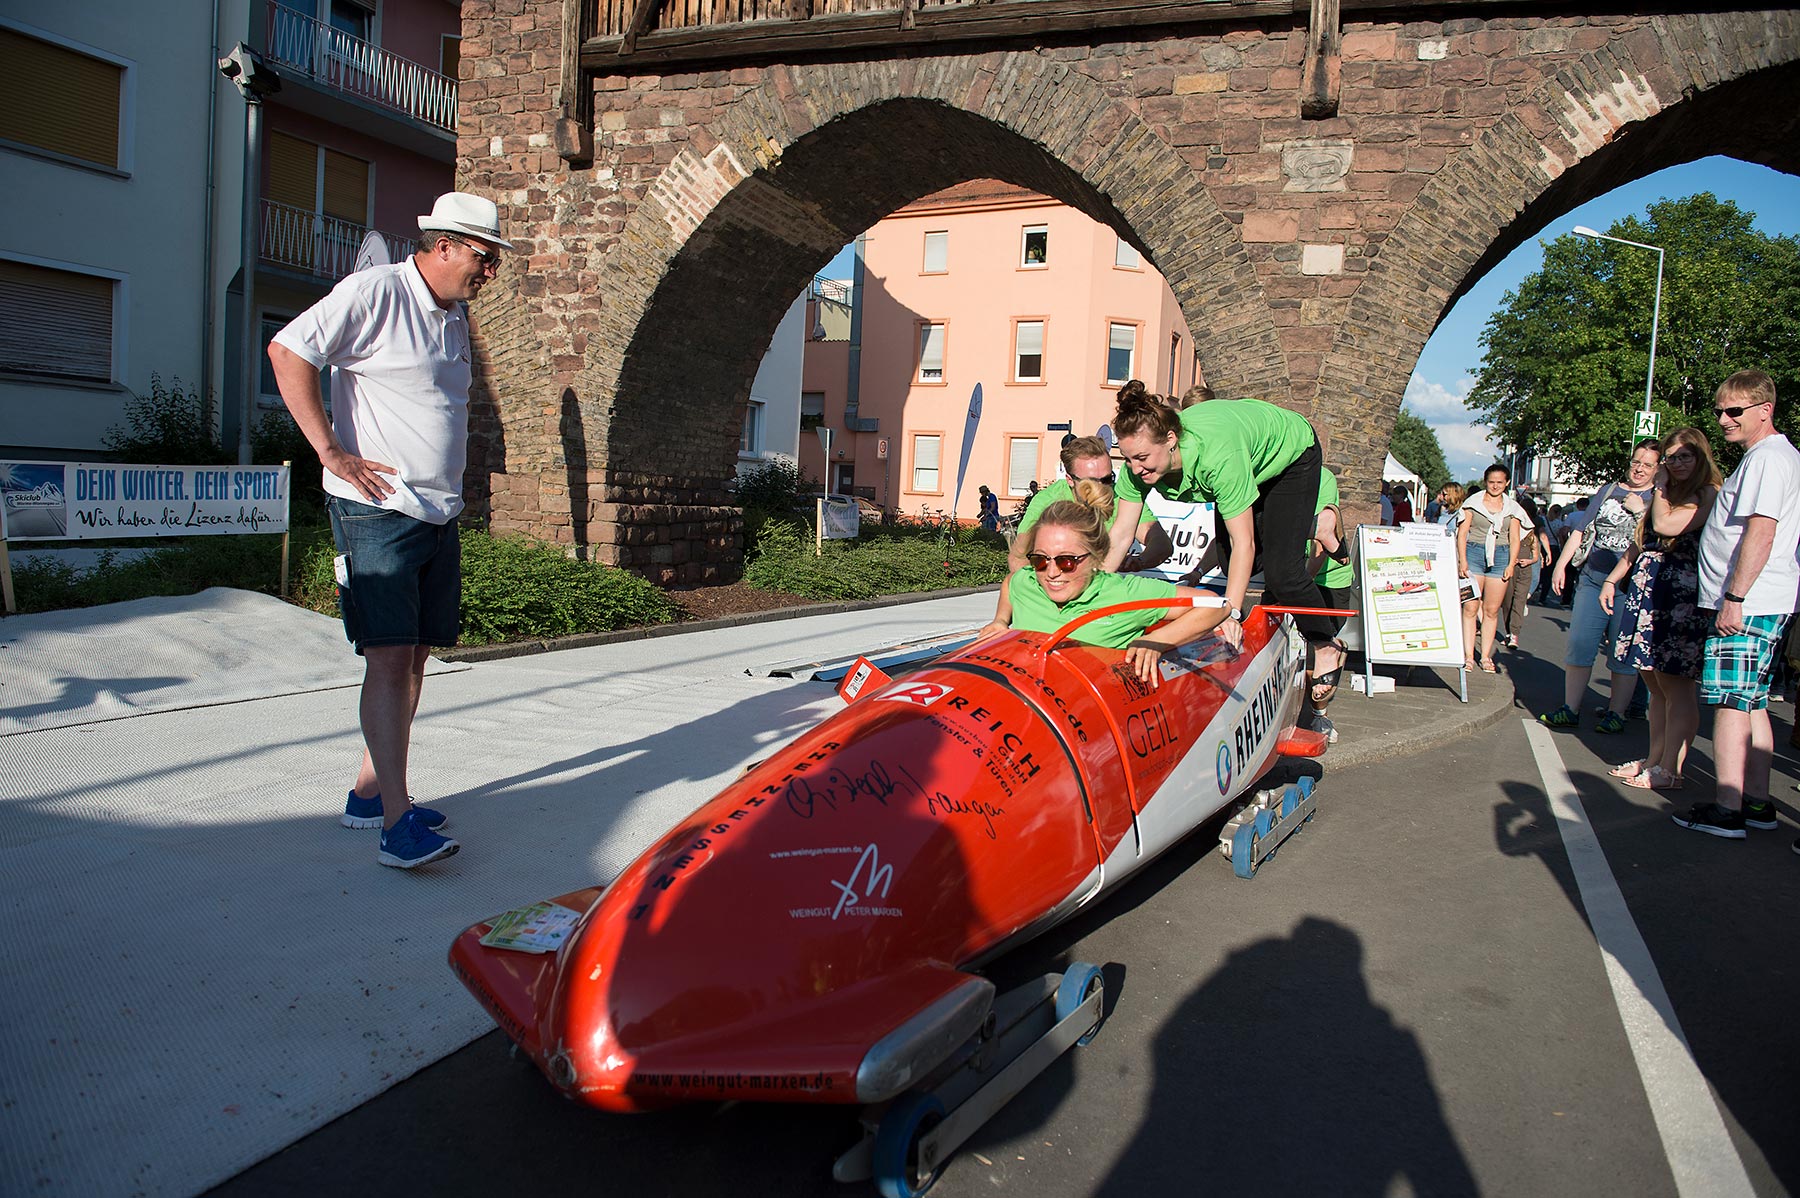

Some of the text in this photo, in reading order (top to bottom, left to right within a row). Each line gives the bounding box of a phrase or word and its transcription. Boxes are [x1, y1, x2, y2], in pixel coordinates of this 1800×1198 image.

[14, 494, 41, 502] Skiclub
[76, 469, 283, 500] DEIN WINTER. DEIN SPORT.
[75, 507, 113, 527] Wir
[117, 506, 155, 527] haben
[160, 506, 182, 528] die
[184, 501, 234, 527] Lizenz
[1127, 703, 1178, 758] GEIL
[1235, 655, 1285, 776] RHEINHE
[947, 696, 1041, 778] REICH
[924, 715, 972, 746] Fenster
[985, 758, 1013, 798] Türen
[998, 746, 1029, 784] GmbH
[789, 906, 902, 918] WEINGUT PETER MARXEN
[634, 1071, 833, 1092] wwwweingut-marxen.de
